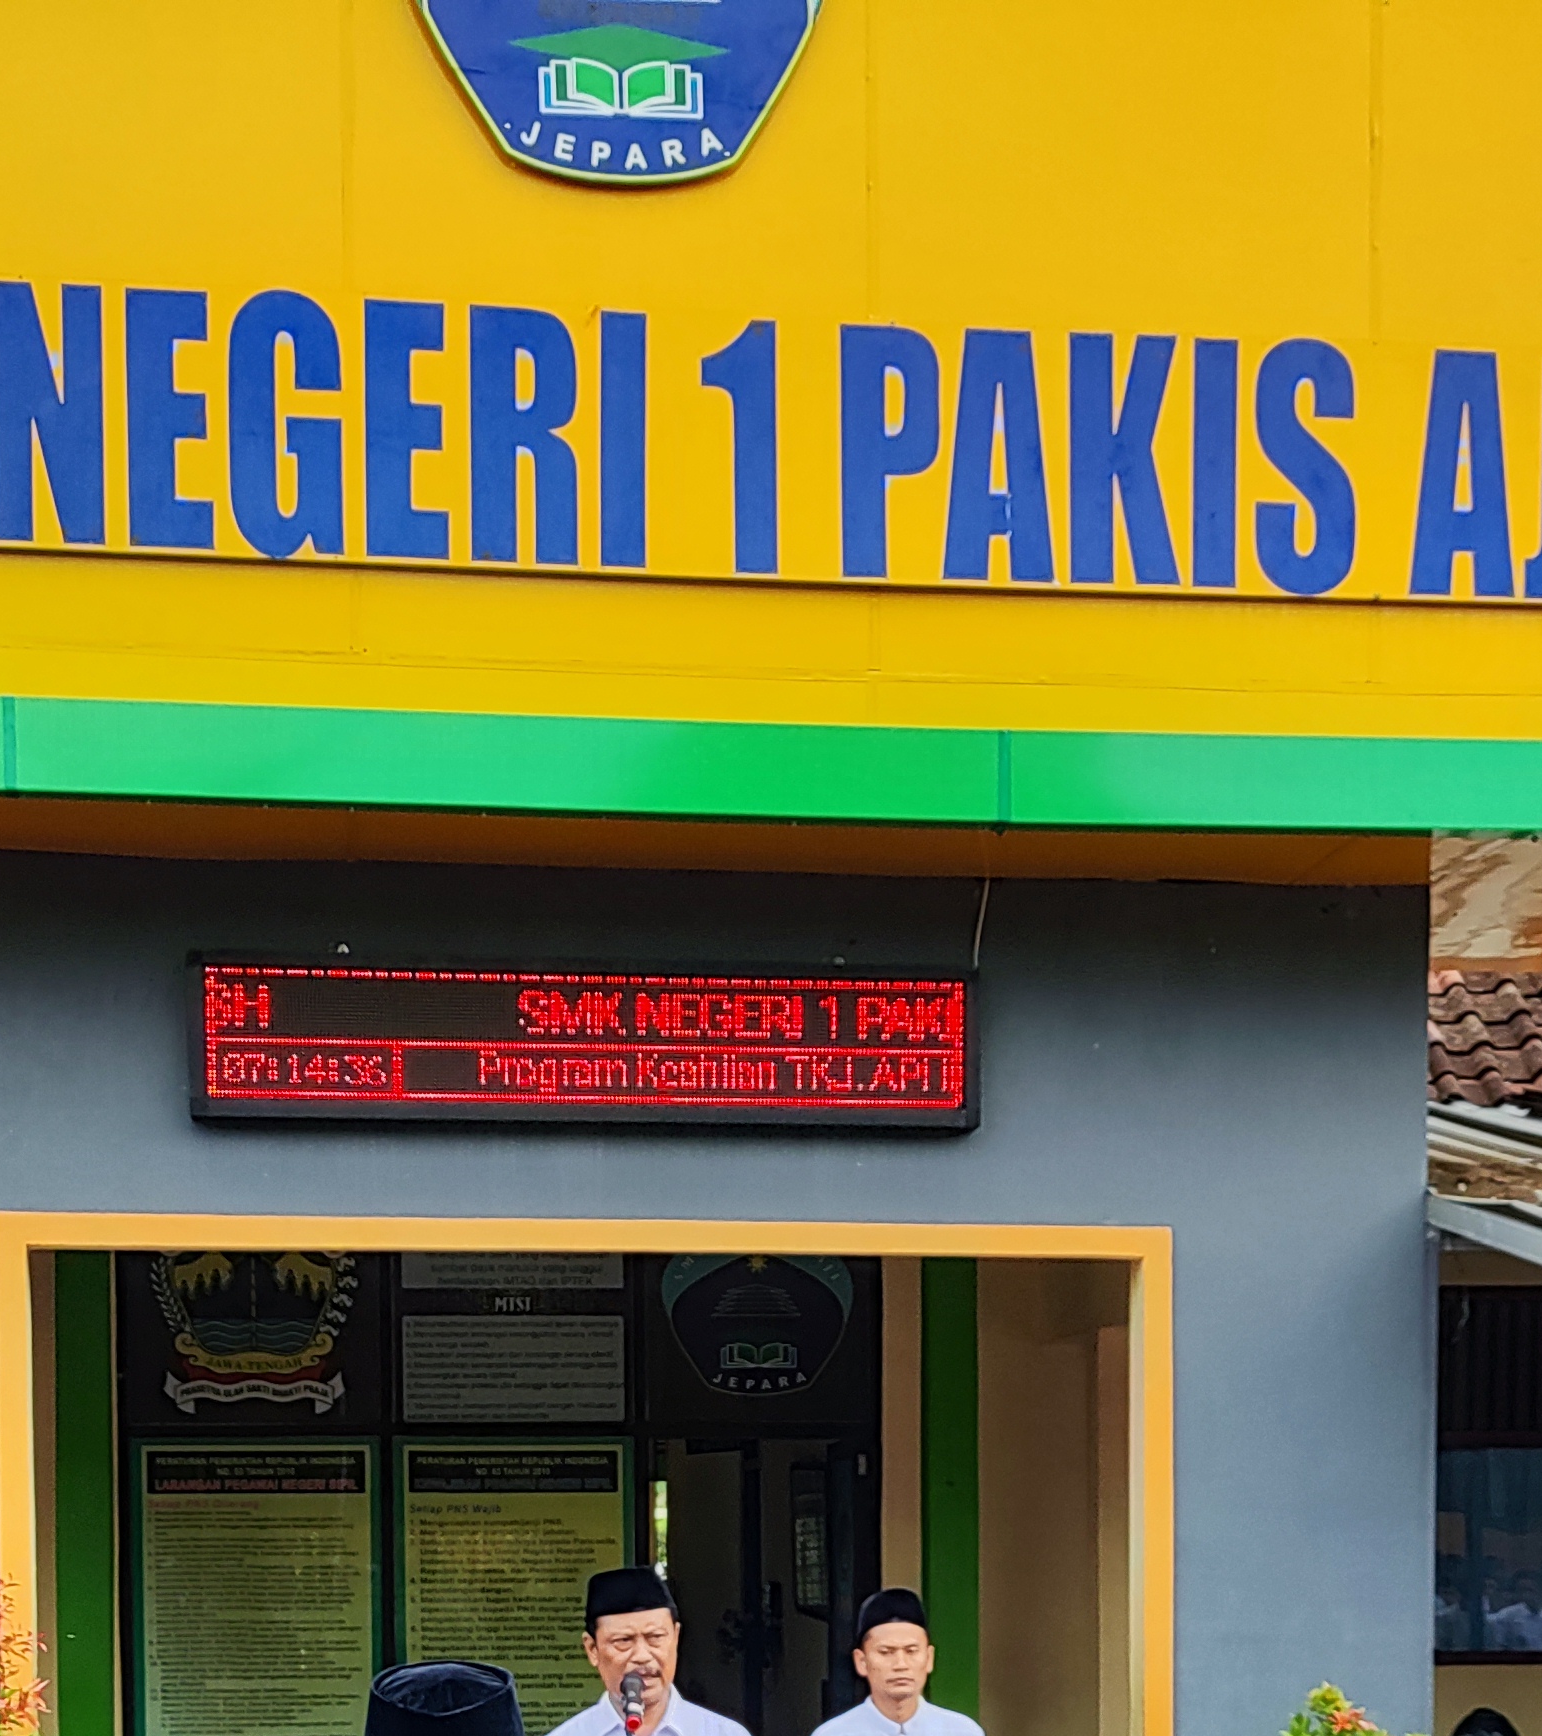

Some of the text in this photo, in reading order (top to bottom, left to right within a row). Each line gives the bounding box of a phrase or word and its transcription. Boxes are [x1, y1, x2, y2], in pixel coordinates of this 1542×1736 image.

[519, 119, 726, 173] JEPARA
[701, 321, 778, 574] 1
[840, 325, 1357, 597] PAKIS
[517, 990, 627, 1037] SMK
[635, 991, 803, 1041] NEGERI
[819, 995, 838, 1041] 1
[222, 1052, 387, 1087] 07:14:36
[477, 1050, 628, 1094] Program
[494, 1296, 532, 1312] MISI
[713, 1371, 808, 1391] JEPARA
[447, 1504, 468, 1513] PNS
[473, 1504, 502, 1515] Wajib
